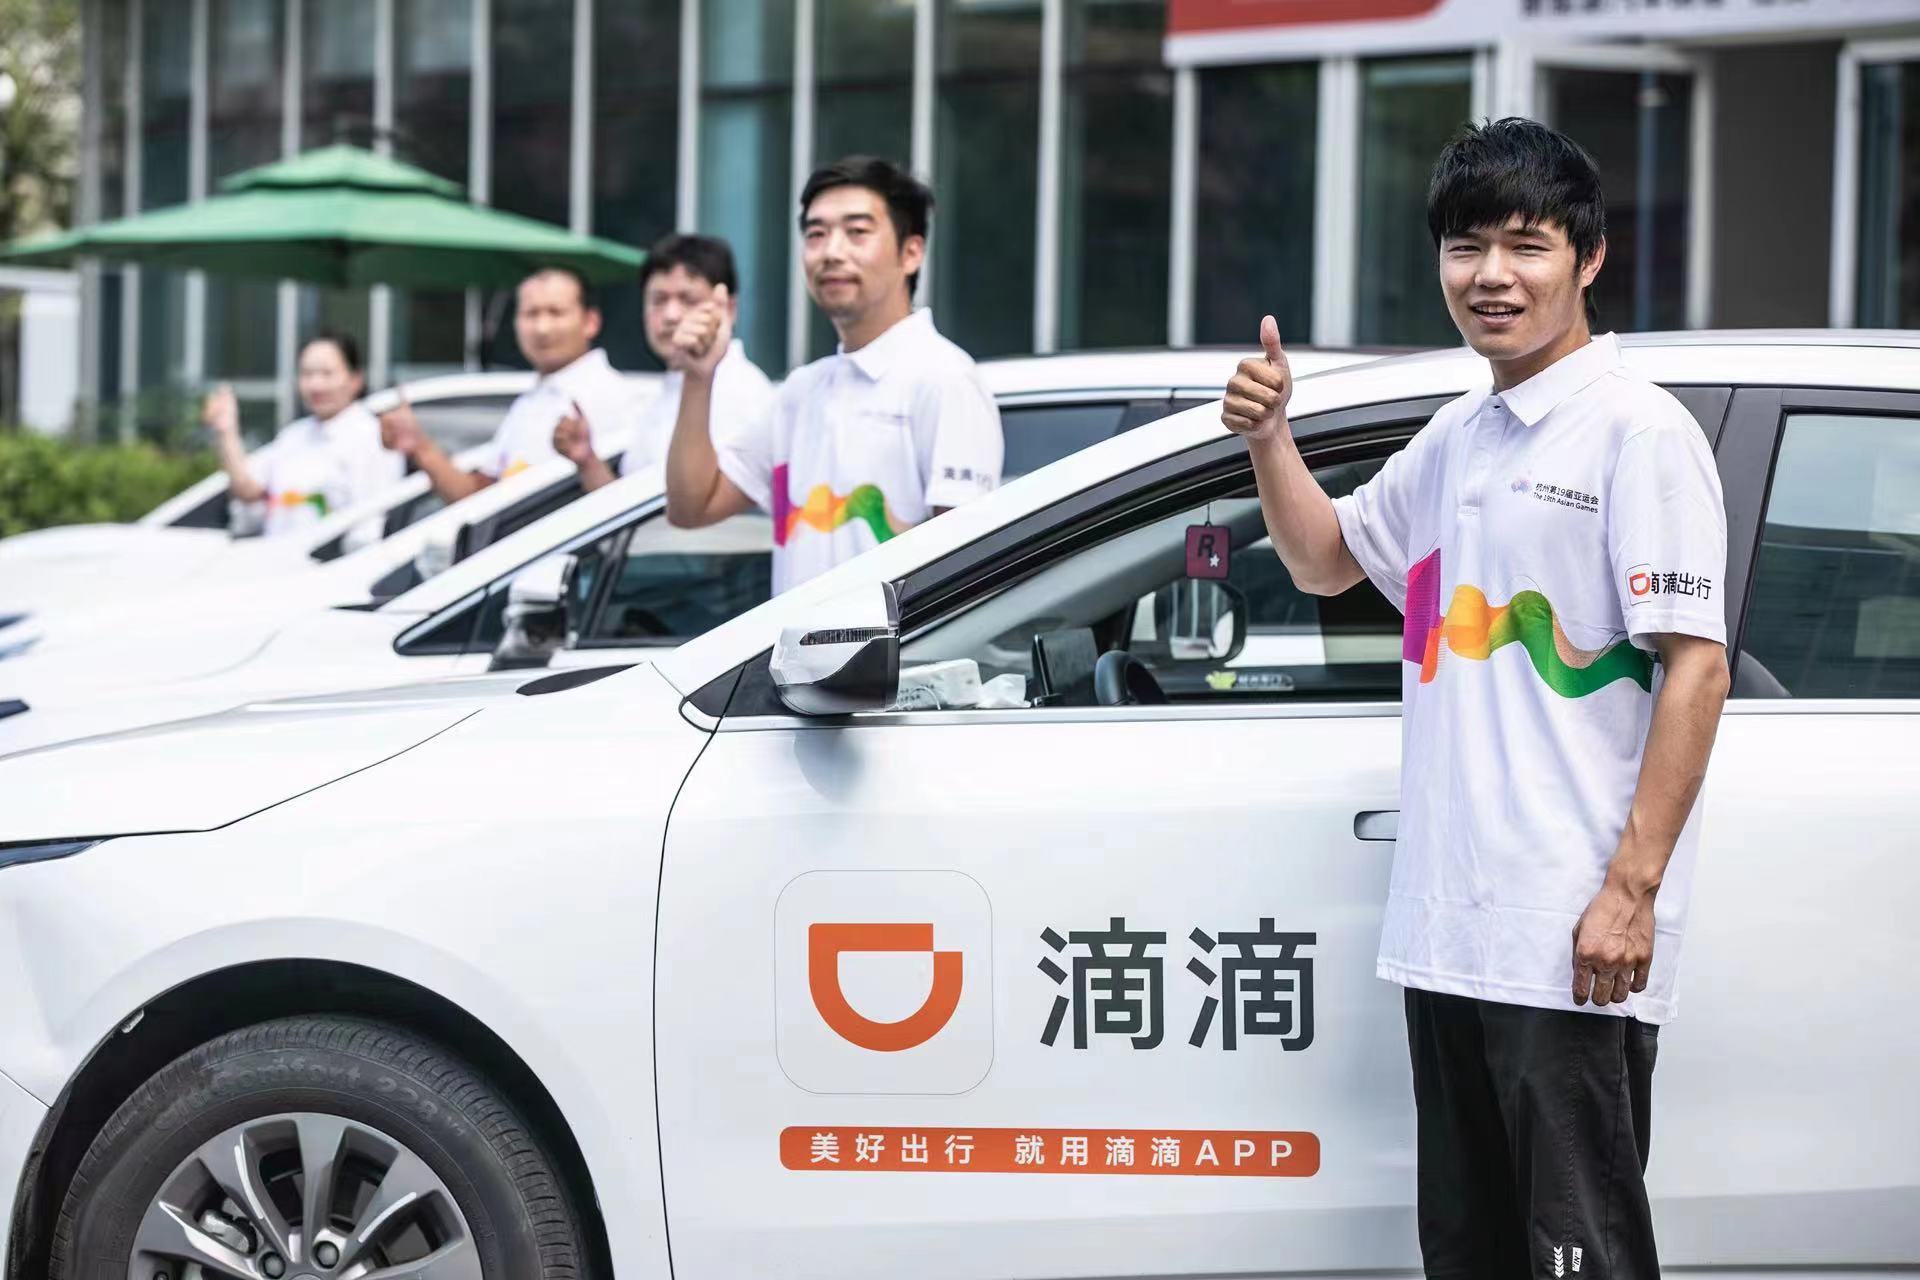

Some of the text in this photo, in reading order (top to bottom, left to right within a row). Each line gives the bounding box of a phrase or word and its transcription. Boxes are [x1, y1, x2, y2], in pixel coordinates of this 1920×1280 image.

[1533, 491, 1599, 513] The 19th Asian Games
[1535, 483, 1600, 505] 杭州第19届亚运会
[1037, 917, 1317, 1051] 滴滴
[810, 1132, 975, 1164] 美好出行
